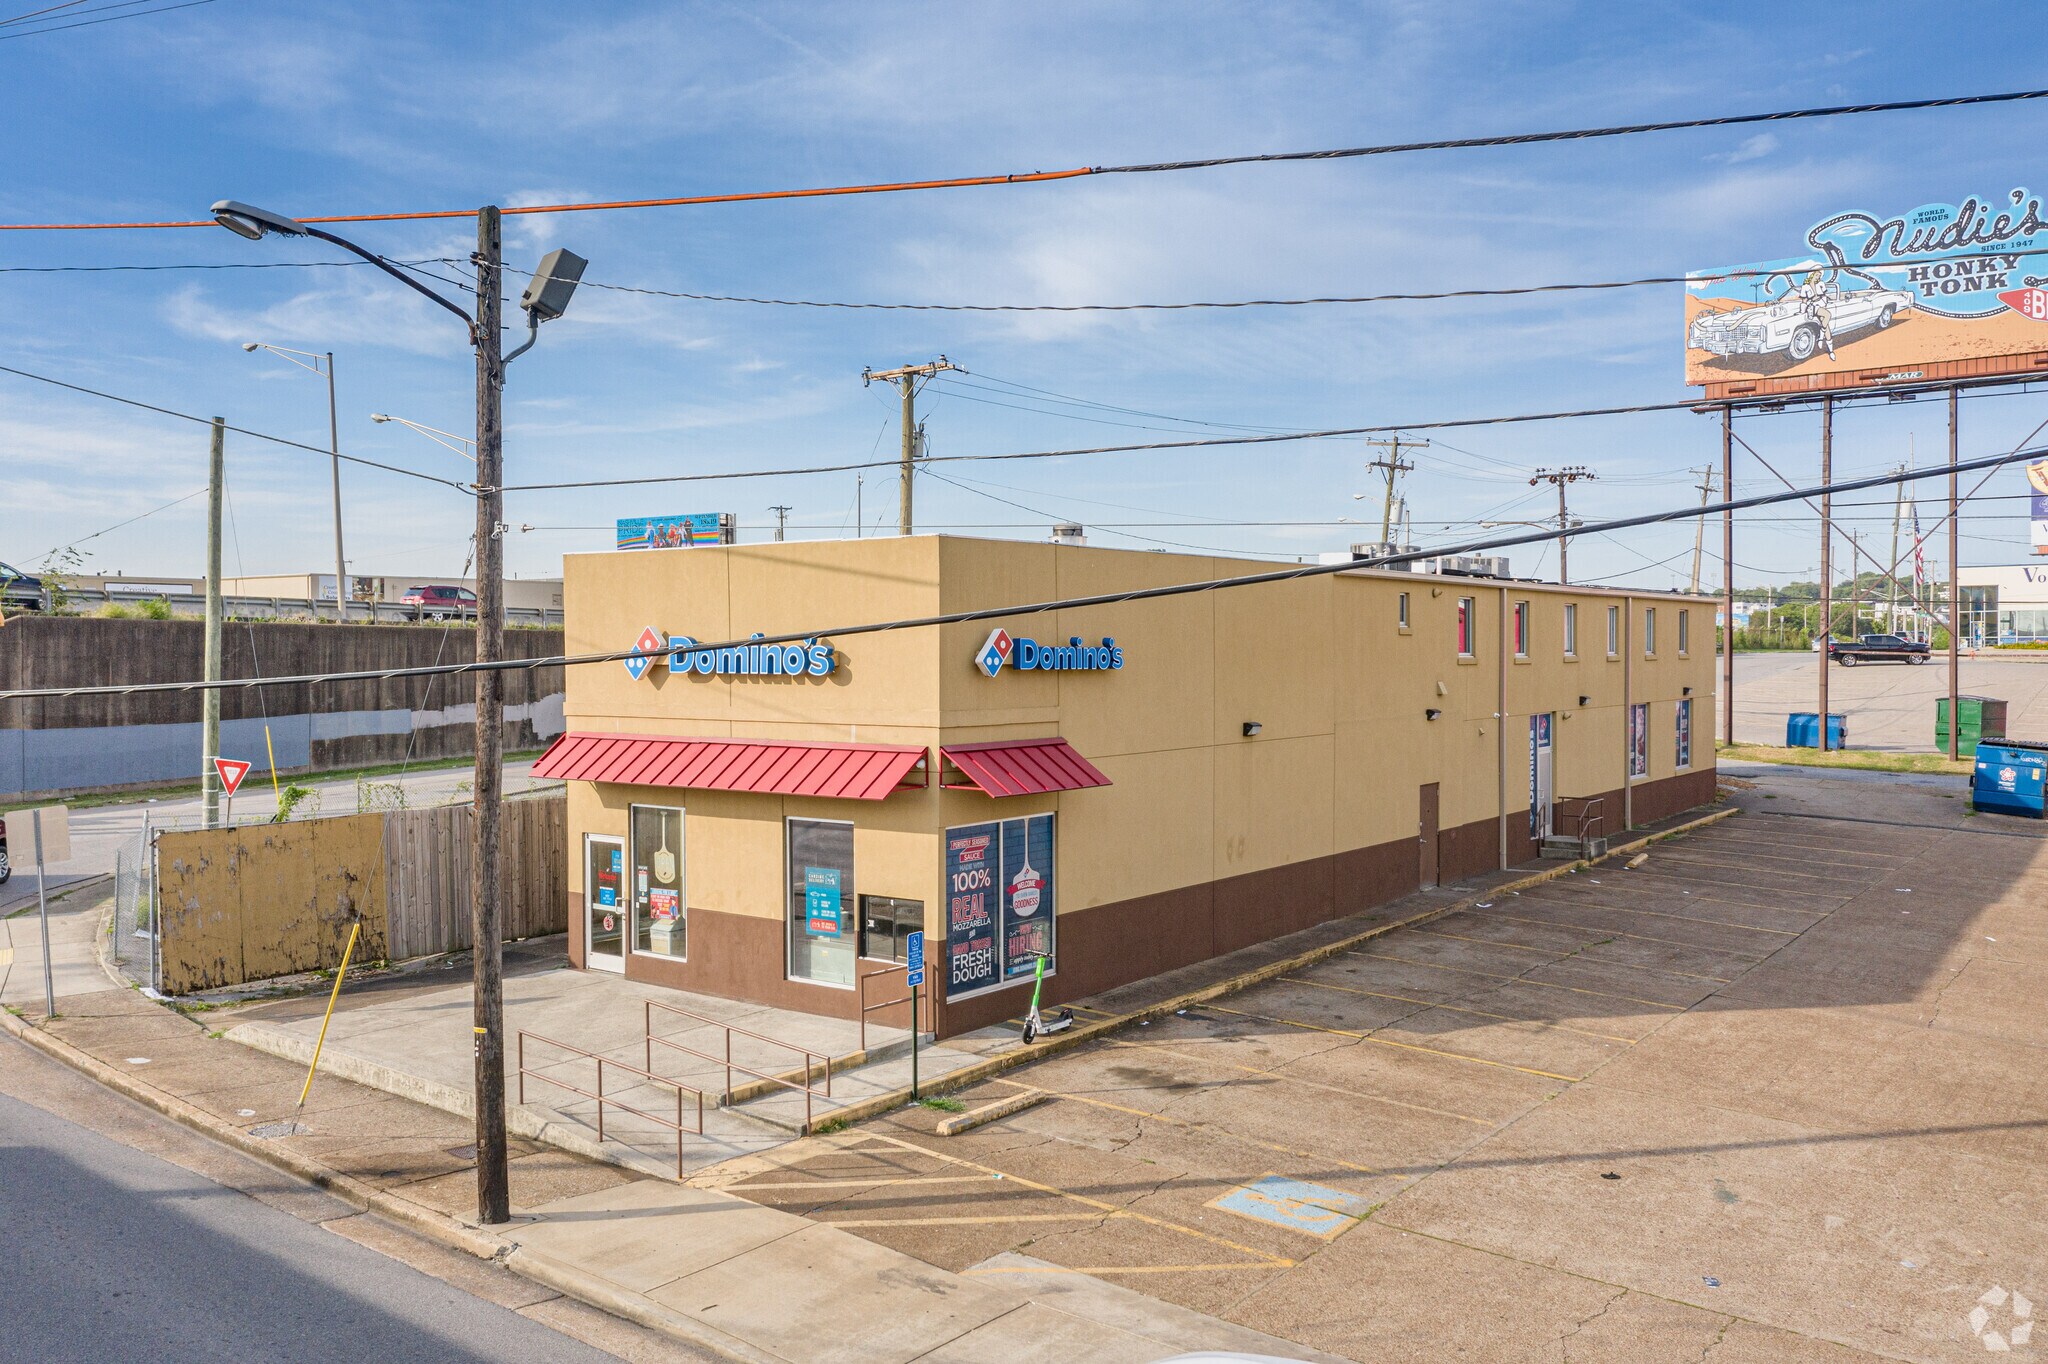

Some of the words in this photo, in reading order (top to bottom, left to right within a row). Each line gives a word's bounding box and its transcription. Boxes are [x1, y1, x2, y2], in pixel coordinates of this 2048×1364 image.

[1912, 214, 1949, 224] FAMOUS
[1918, 208, 1946, 217] WORLD
[1980, 243, 2007, 252] SINCE
[2010, 239, 2034, 248] 1947
[1908, 255, 2022, 282] HONKY
[1919, 272, 2008, 297] TONK
[668, 633, 834, 676] Domino's
[1016, 637, 1124, 670] Domino's
[963, 852, 980, 861] SAUCE
[952, 868, 991, 893] 100%
[1016, 879, 1036, 890] WELCOME
[952, 892, 988, 924] REAL
[1014, 897, 1038, 909] GOODNESS
[953, 917, 991, 932] MOZZARELLA
[1008, 931, 1043, 958] HIRING
[953, 947, 991, 971] FRESH
[953, 962, 991, 985] DOUGH
